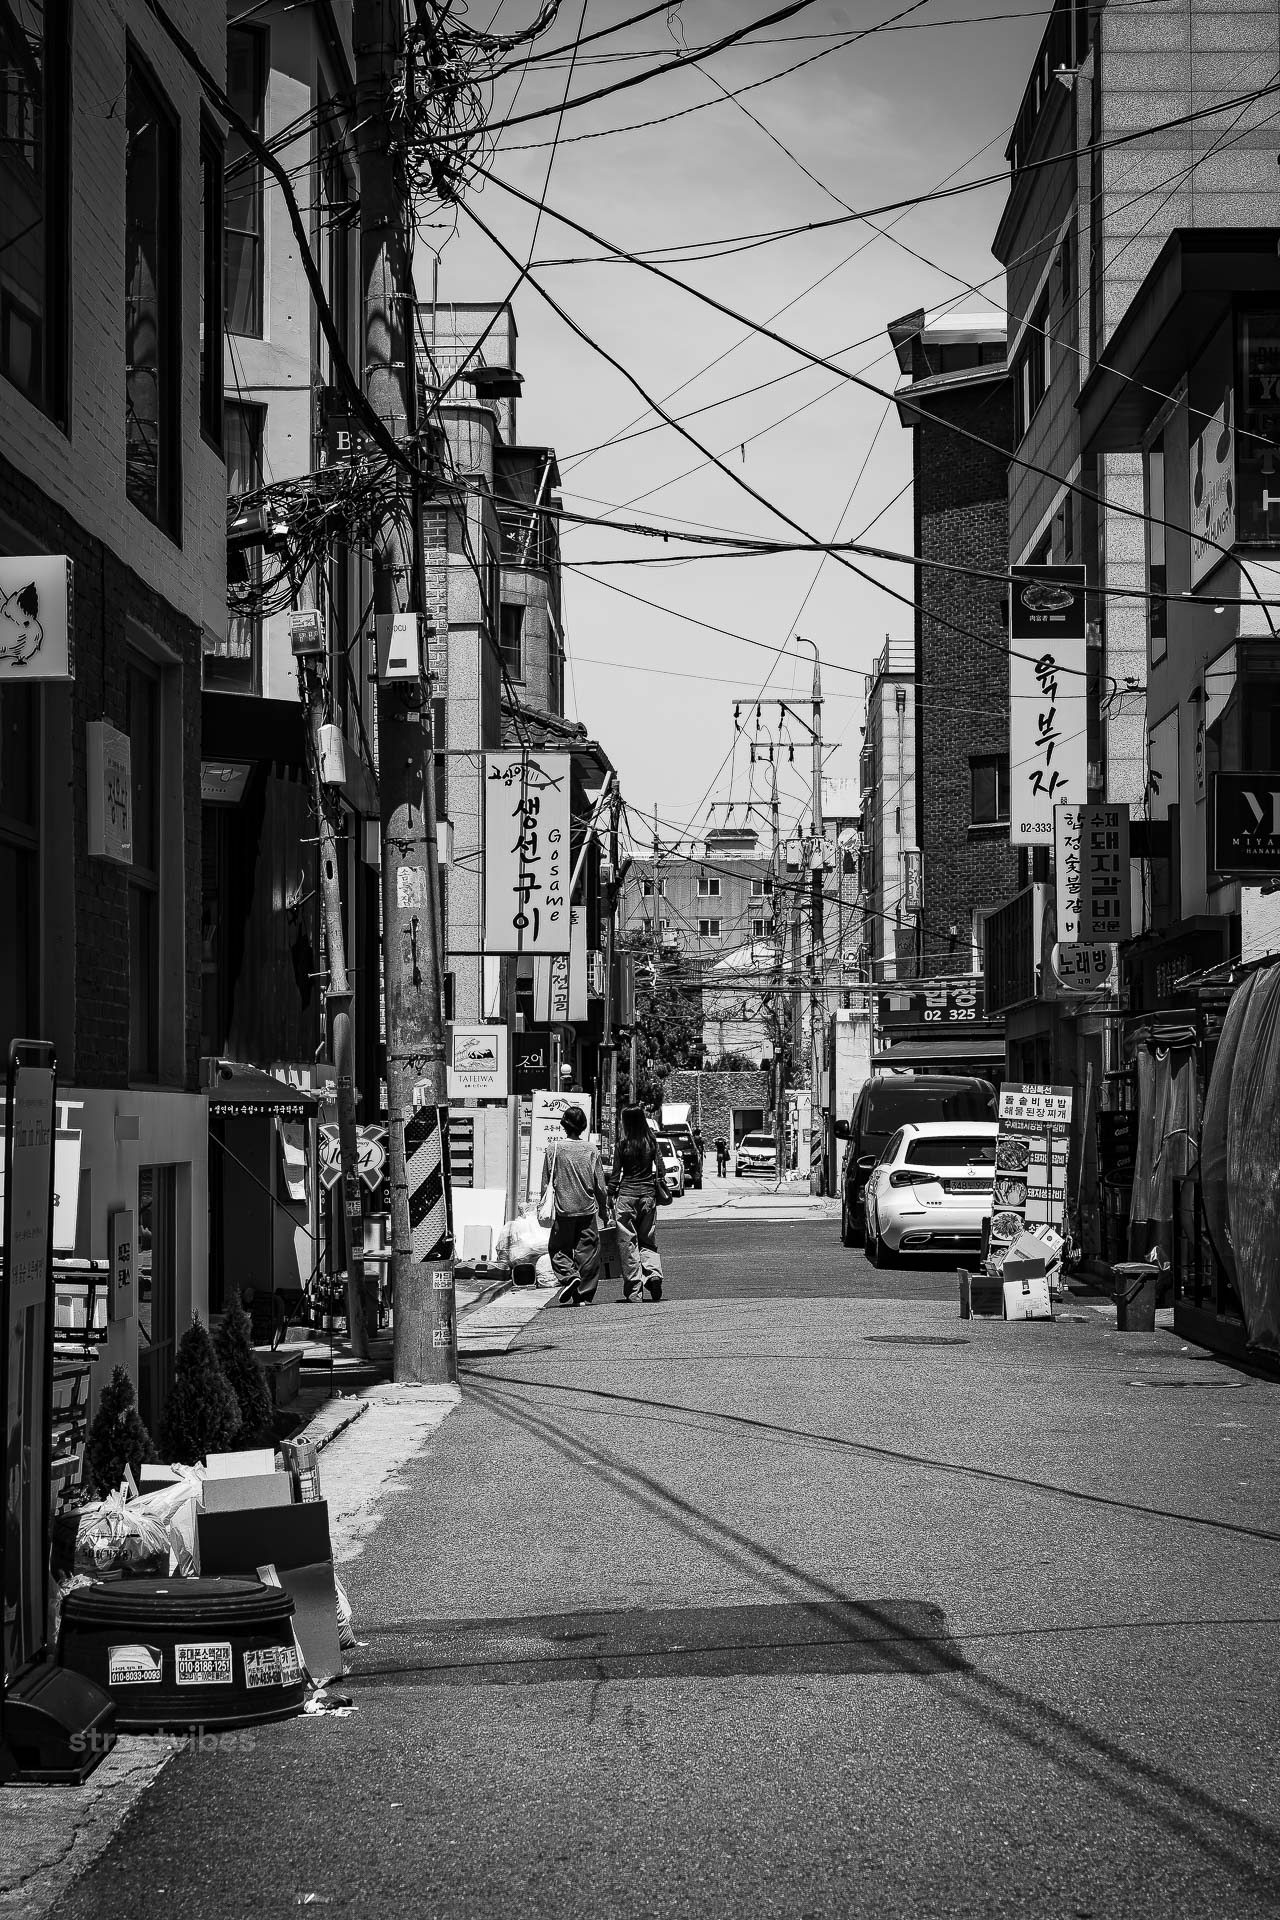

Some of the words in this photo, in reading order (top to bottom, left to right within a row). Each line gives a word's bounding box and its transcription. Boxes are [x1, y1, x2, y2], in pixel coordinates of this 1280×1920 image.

[1029, 653, 1068, 799] 육부자
[1090, 812, 1119, 828] 수제
[511, 797, 541, 941] 생선구이
[546, 829, 563, 921] Gosame
[1064, 813, 1085, 934] 합정숯불갈비
[1090, 831, 1121, 918] 돼지갈비
[1092, 921, 1121, 933] 전문
[1060, 949, 1107, 975] 노래방
[924, 1010, 942, 1020] 02
[949, 1009, 976, 1020] 325
[1022, 1084, 1052, 1095] 점심특선
[1004, 1106, 1067, 1119] 해물된장찌개
[1005, 1095, 1067, 1109] 돌솥비빔밥
